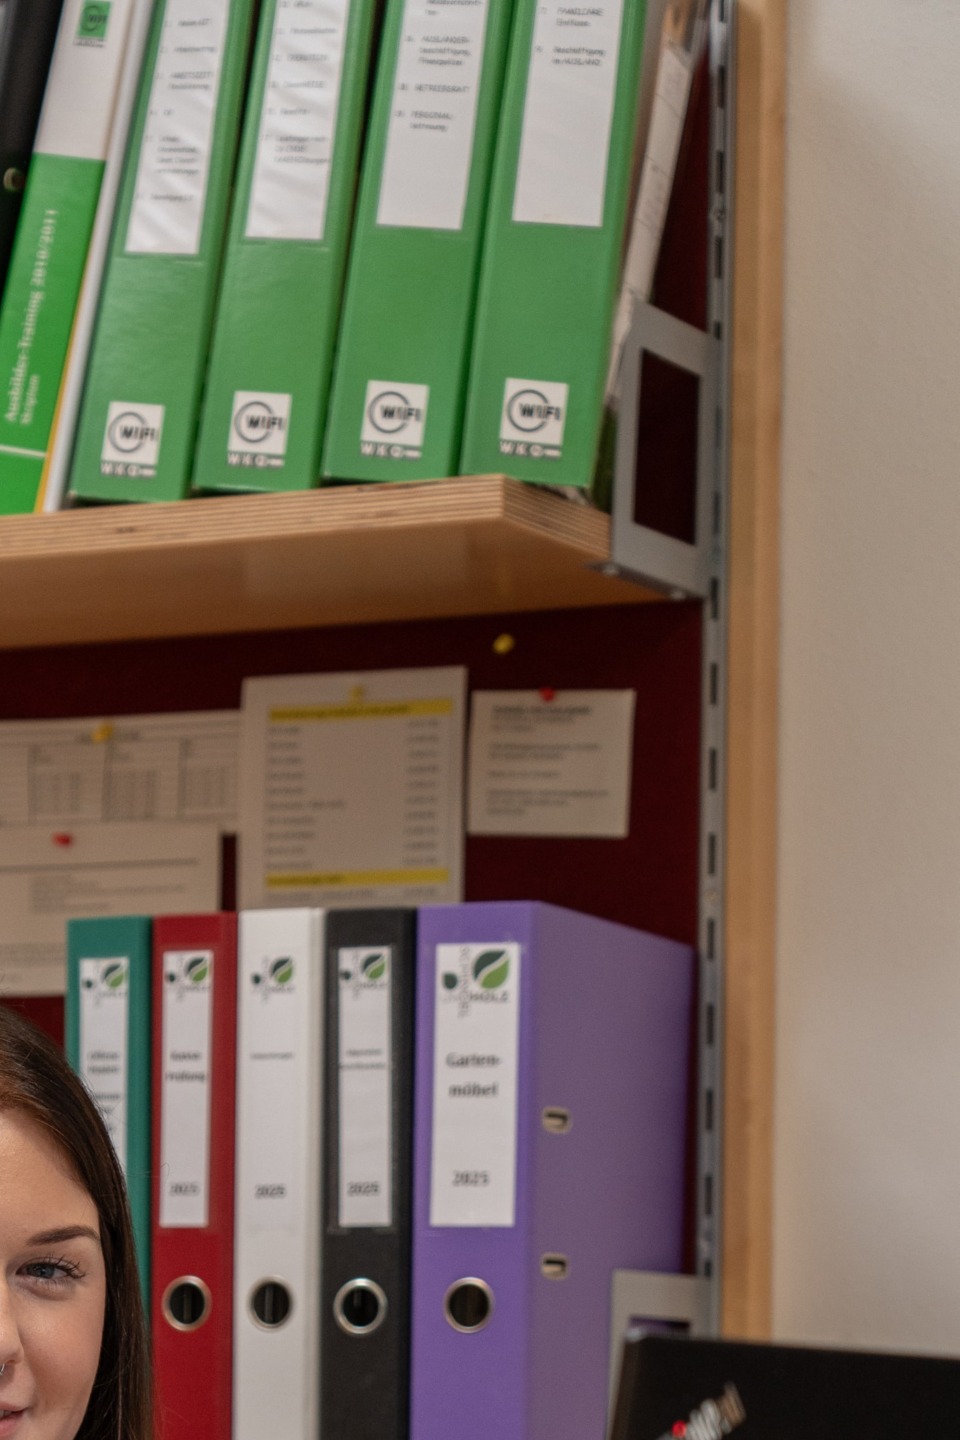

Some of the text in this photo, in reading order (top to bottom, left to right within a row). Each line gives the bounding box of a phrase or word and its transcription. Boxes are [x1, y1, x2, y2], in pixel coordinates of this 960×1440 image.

[380, 404, 422, 422] WIFI
[518, 402, 562, 421] WIFI
[245, 415, 286, 431] WIFI
[119, 424, 158, 442] WIFI
[445, 1051, 501, 1069] Garten-
[448, 1080, 500, 1098] möbel
